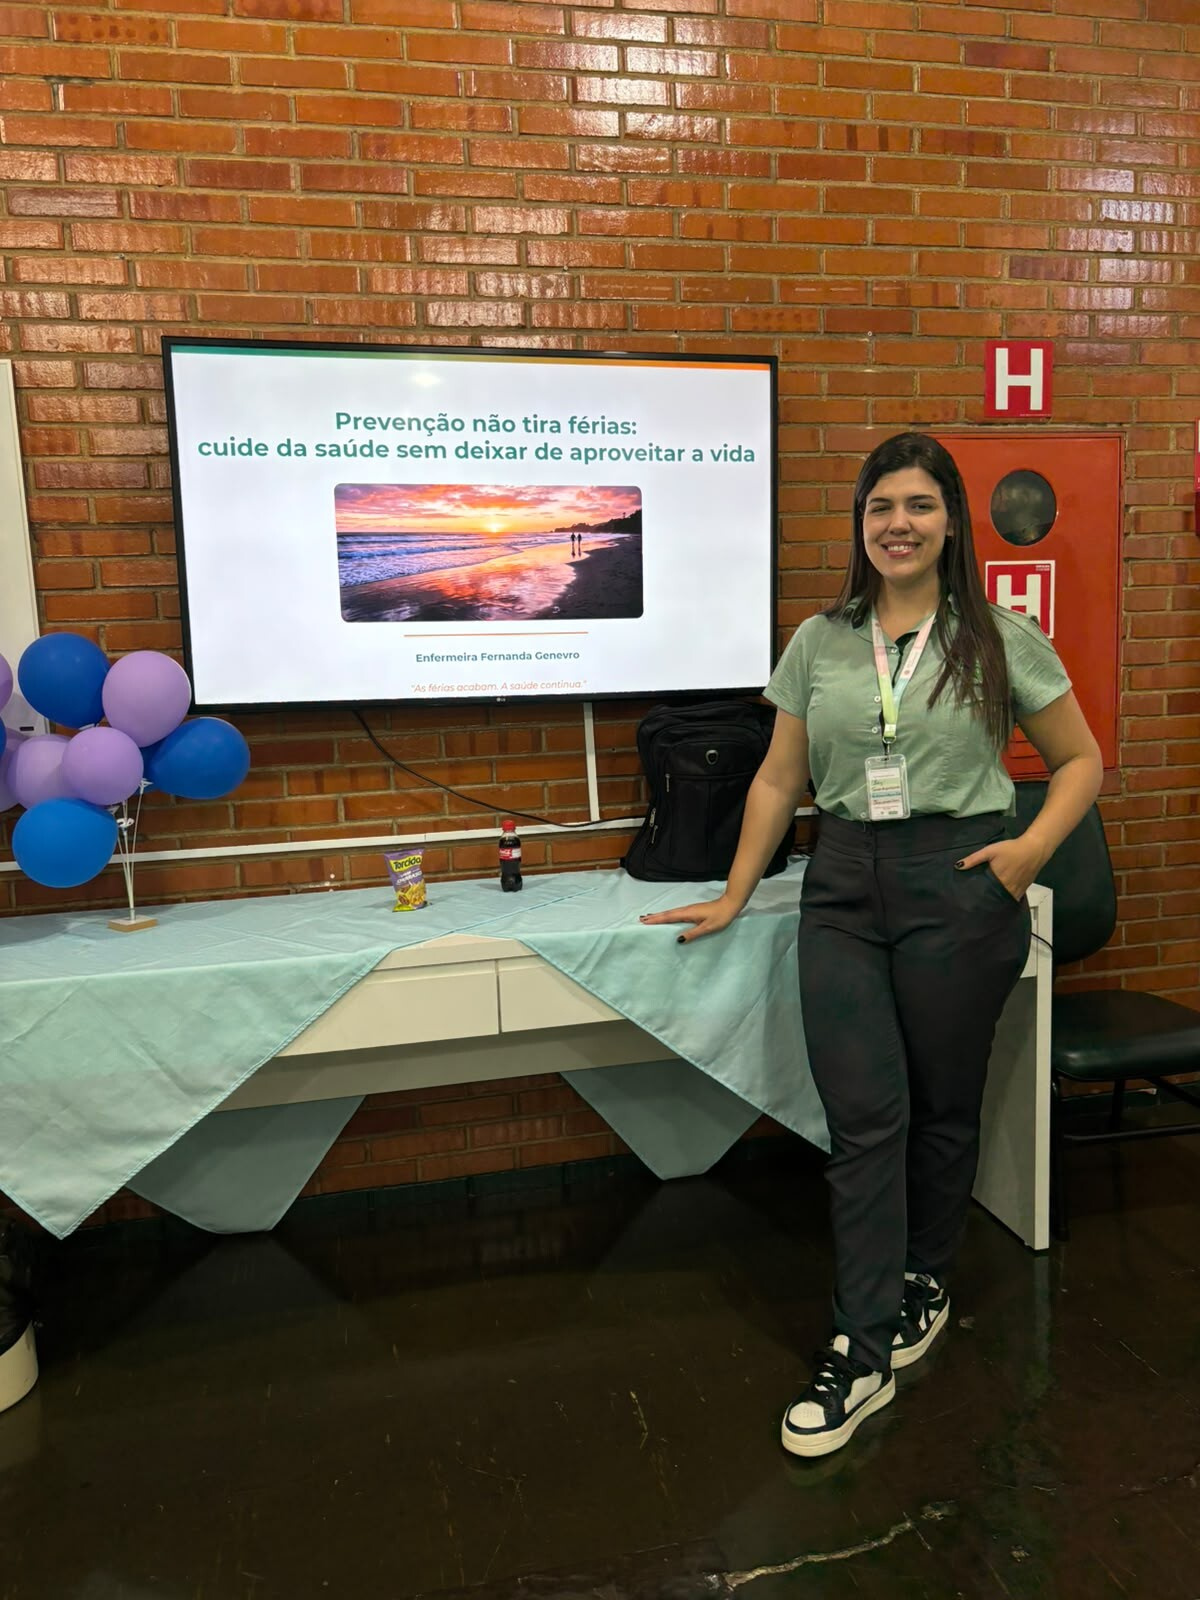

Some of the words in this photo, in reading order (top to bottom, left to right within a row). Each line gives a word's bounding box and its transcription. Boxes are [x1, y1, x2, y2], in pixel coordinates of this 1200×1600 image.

[995, 347, 1043, 411] H
[335, 412, 465, 437] Prevenção
[472, 413, 516, 433] não
[522, 413, 561, 434] tira
[568, 415, 637, 435] férias:
[198, 436, 269, 457] cuide
[276, 438, 308, 458] da
[315, 438, 390, 459] saúde
[396, 444, 447, 460] sem
[454, 440, 528, 461] deixar
[534, 442, 564, 461] de
[569, 442, 686, 465] aproveitar
[691, 448, 704, 463] a
[710, 443, 756, 463] vida
[997, 574, 1041, 624] H
[415, 652, 478, 663] Enfermeira
[480, 651, 533, 662] Fernanda
[535, 650, 580, 660] Genevro
[427, 682, 455, 693] férias
[456, 680, 499, 692] acabam.
[501, 681, 509, 690] A
[510, 680, 539, 691] saúde
